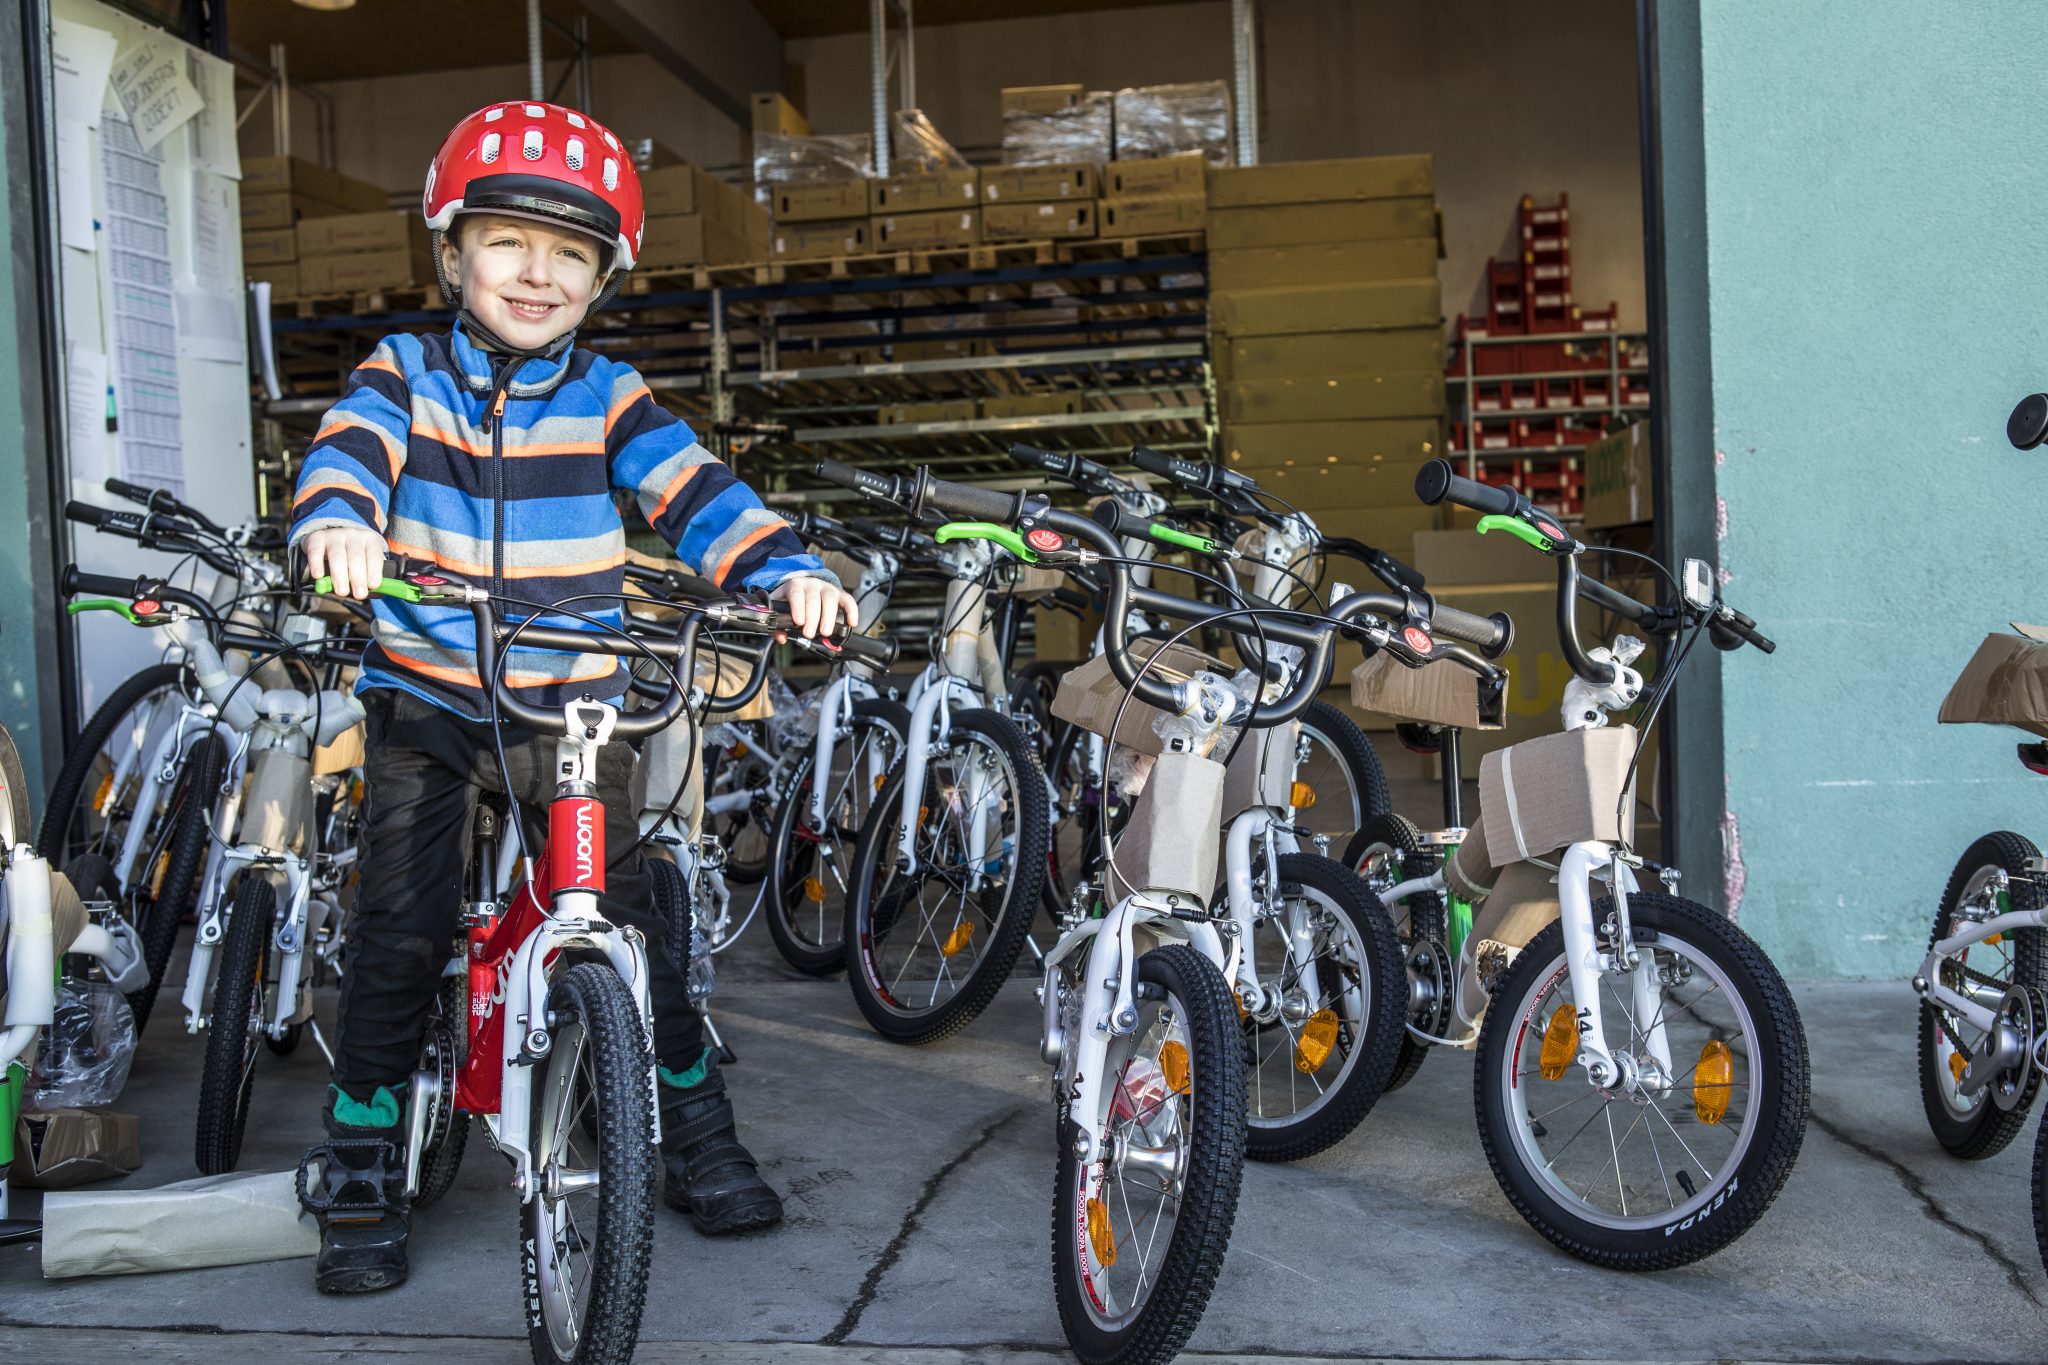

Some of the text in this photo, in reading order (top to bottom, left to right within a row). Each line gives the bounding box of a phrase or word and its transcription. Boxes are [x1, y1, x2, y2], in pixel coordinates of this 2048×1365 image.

[785, 756, 809, 800] KENDA
[576, 802, 592, 884] woom
[1578, 1007, 1593, 1035] 14
[1665, 1177, 1738, 1237] KENDA
[526, 1238, 541, 1328] KENDA
